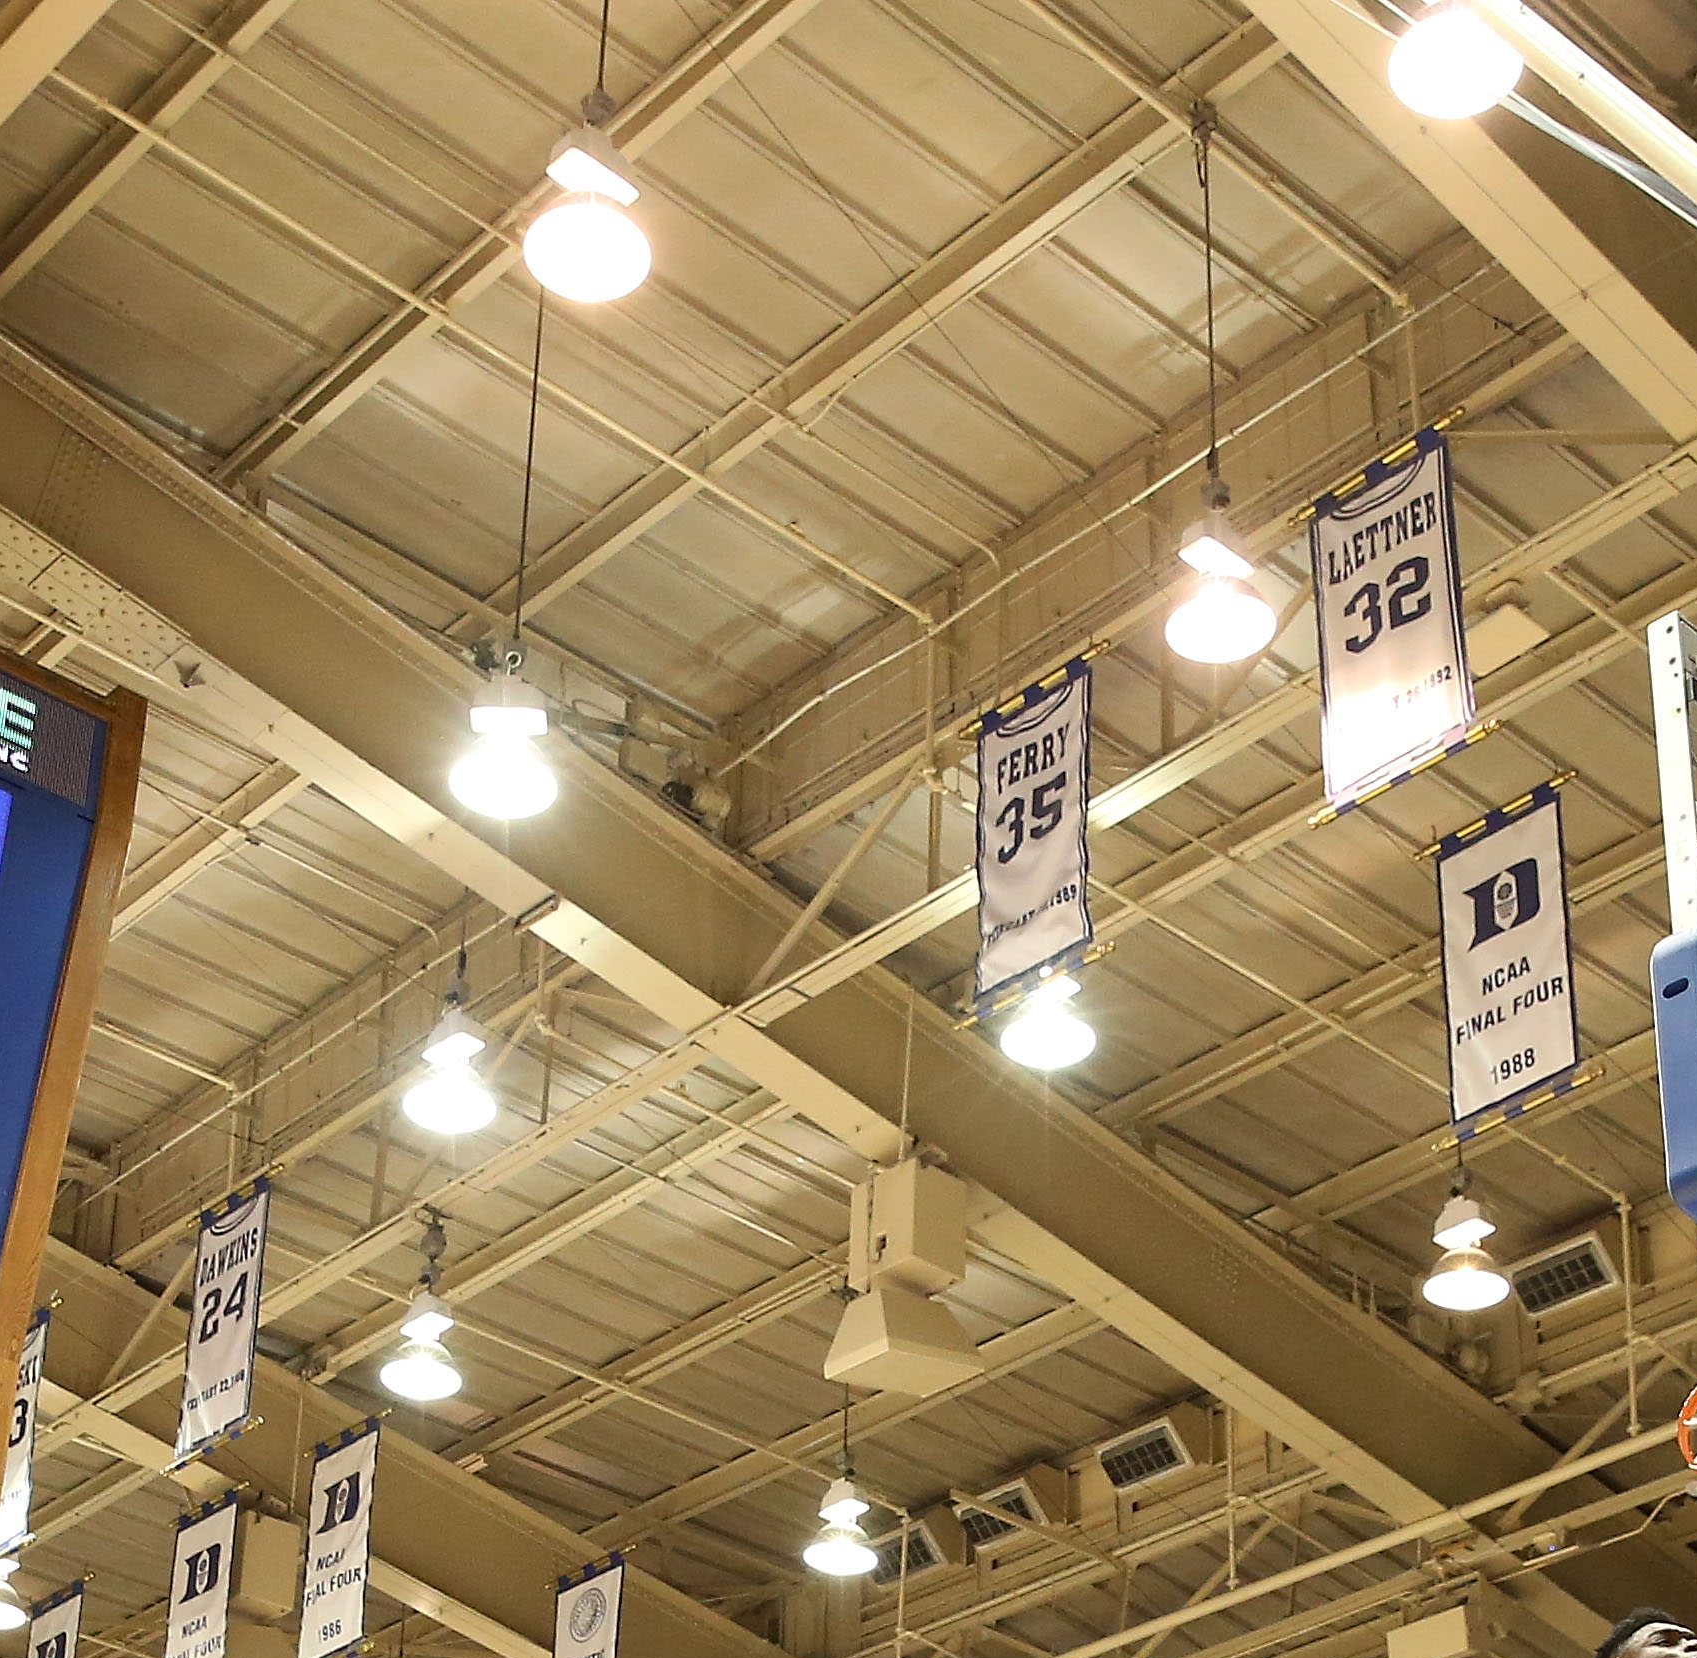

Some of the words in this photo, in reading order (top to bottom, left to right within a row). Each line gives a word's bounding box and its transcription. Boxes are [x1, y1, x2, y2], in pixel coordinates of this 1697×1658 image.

[1327, 493, 1438, 586] LAETTNER
[1343, 555, 1431, 655] 32
[996, 722, 1071, 796] FERRY
[995, 771, 1067, 865] 35
[1455, 1002, 1507, 1045] FINAL
[1512, 976, 1565, 1019] FOUR
[1481, 955, 1532, 995] NCAA
[1490, 1047, 1537, 1087] 1988
[199, 1227, 258, 1287] DAWKINS
[198, 1271, 248, 1344] 24
